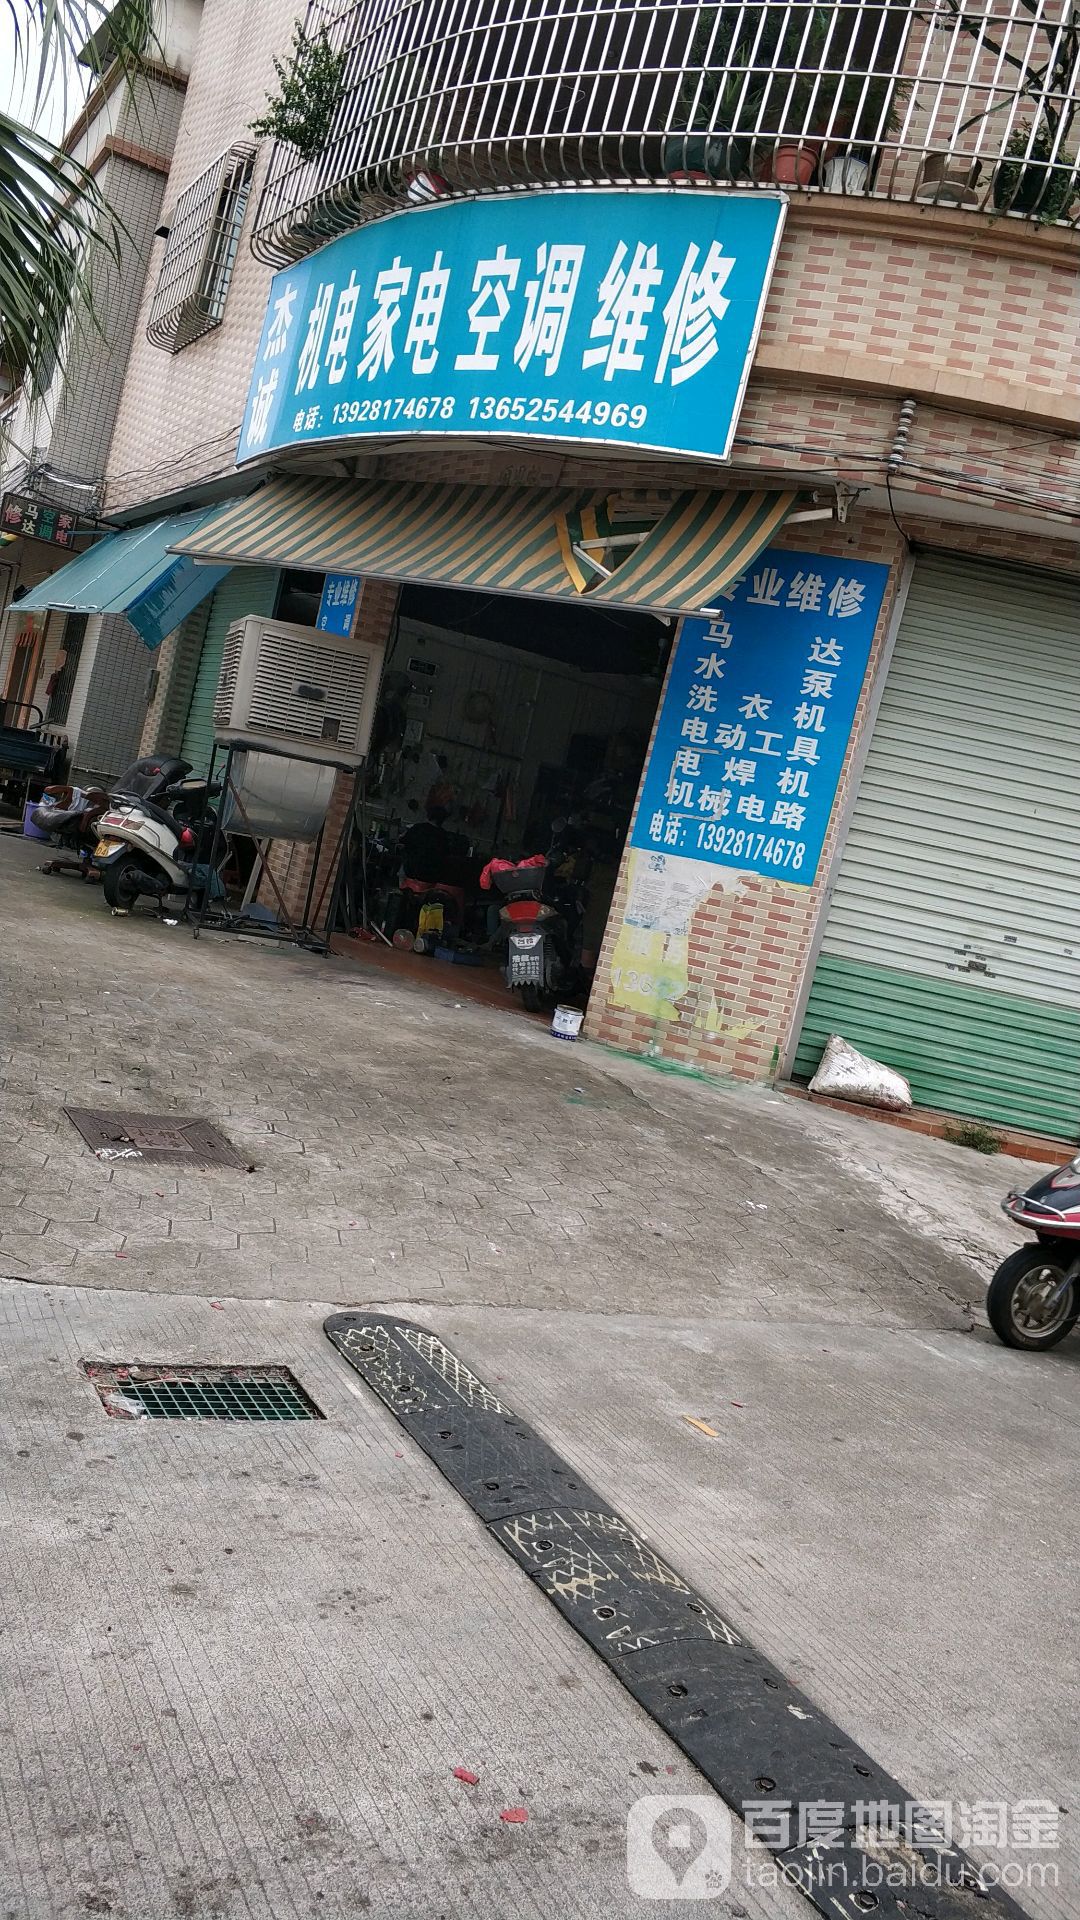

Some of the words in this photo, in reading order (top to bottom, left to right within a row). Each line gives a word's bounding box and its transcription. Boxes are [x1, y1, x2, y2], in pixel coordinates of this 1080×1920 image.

[294, 239, 737, 396] 机电家电空调维修
[247, 282, 298, 448] 杰诚
[331, 396, 456, 424] 13928174678
[467, 396, 648, 430] 13652544969
[5, 503, 23, 524] 修
[680, 716, 821, 767] 电动工具
[664, 778, 807, 832] 机械电路
[696, 822, 806, 870] 13928174678
